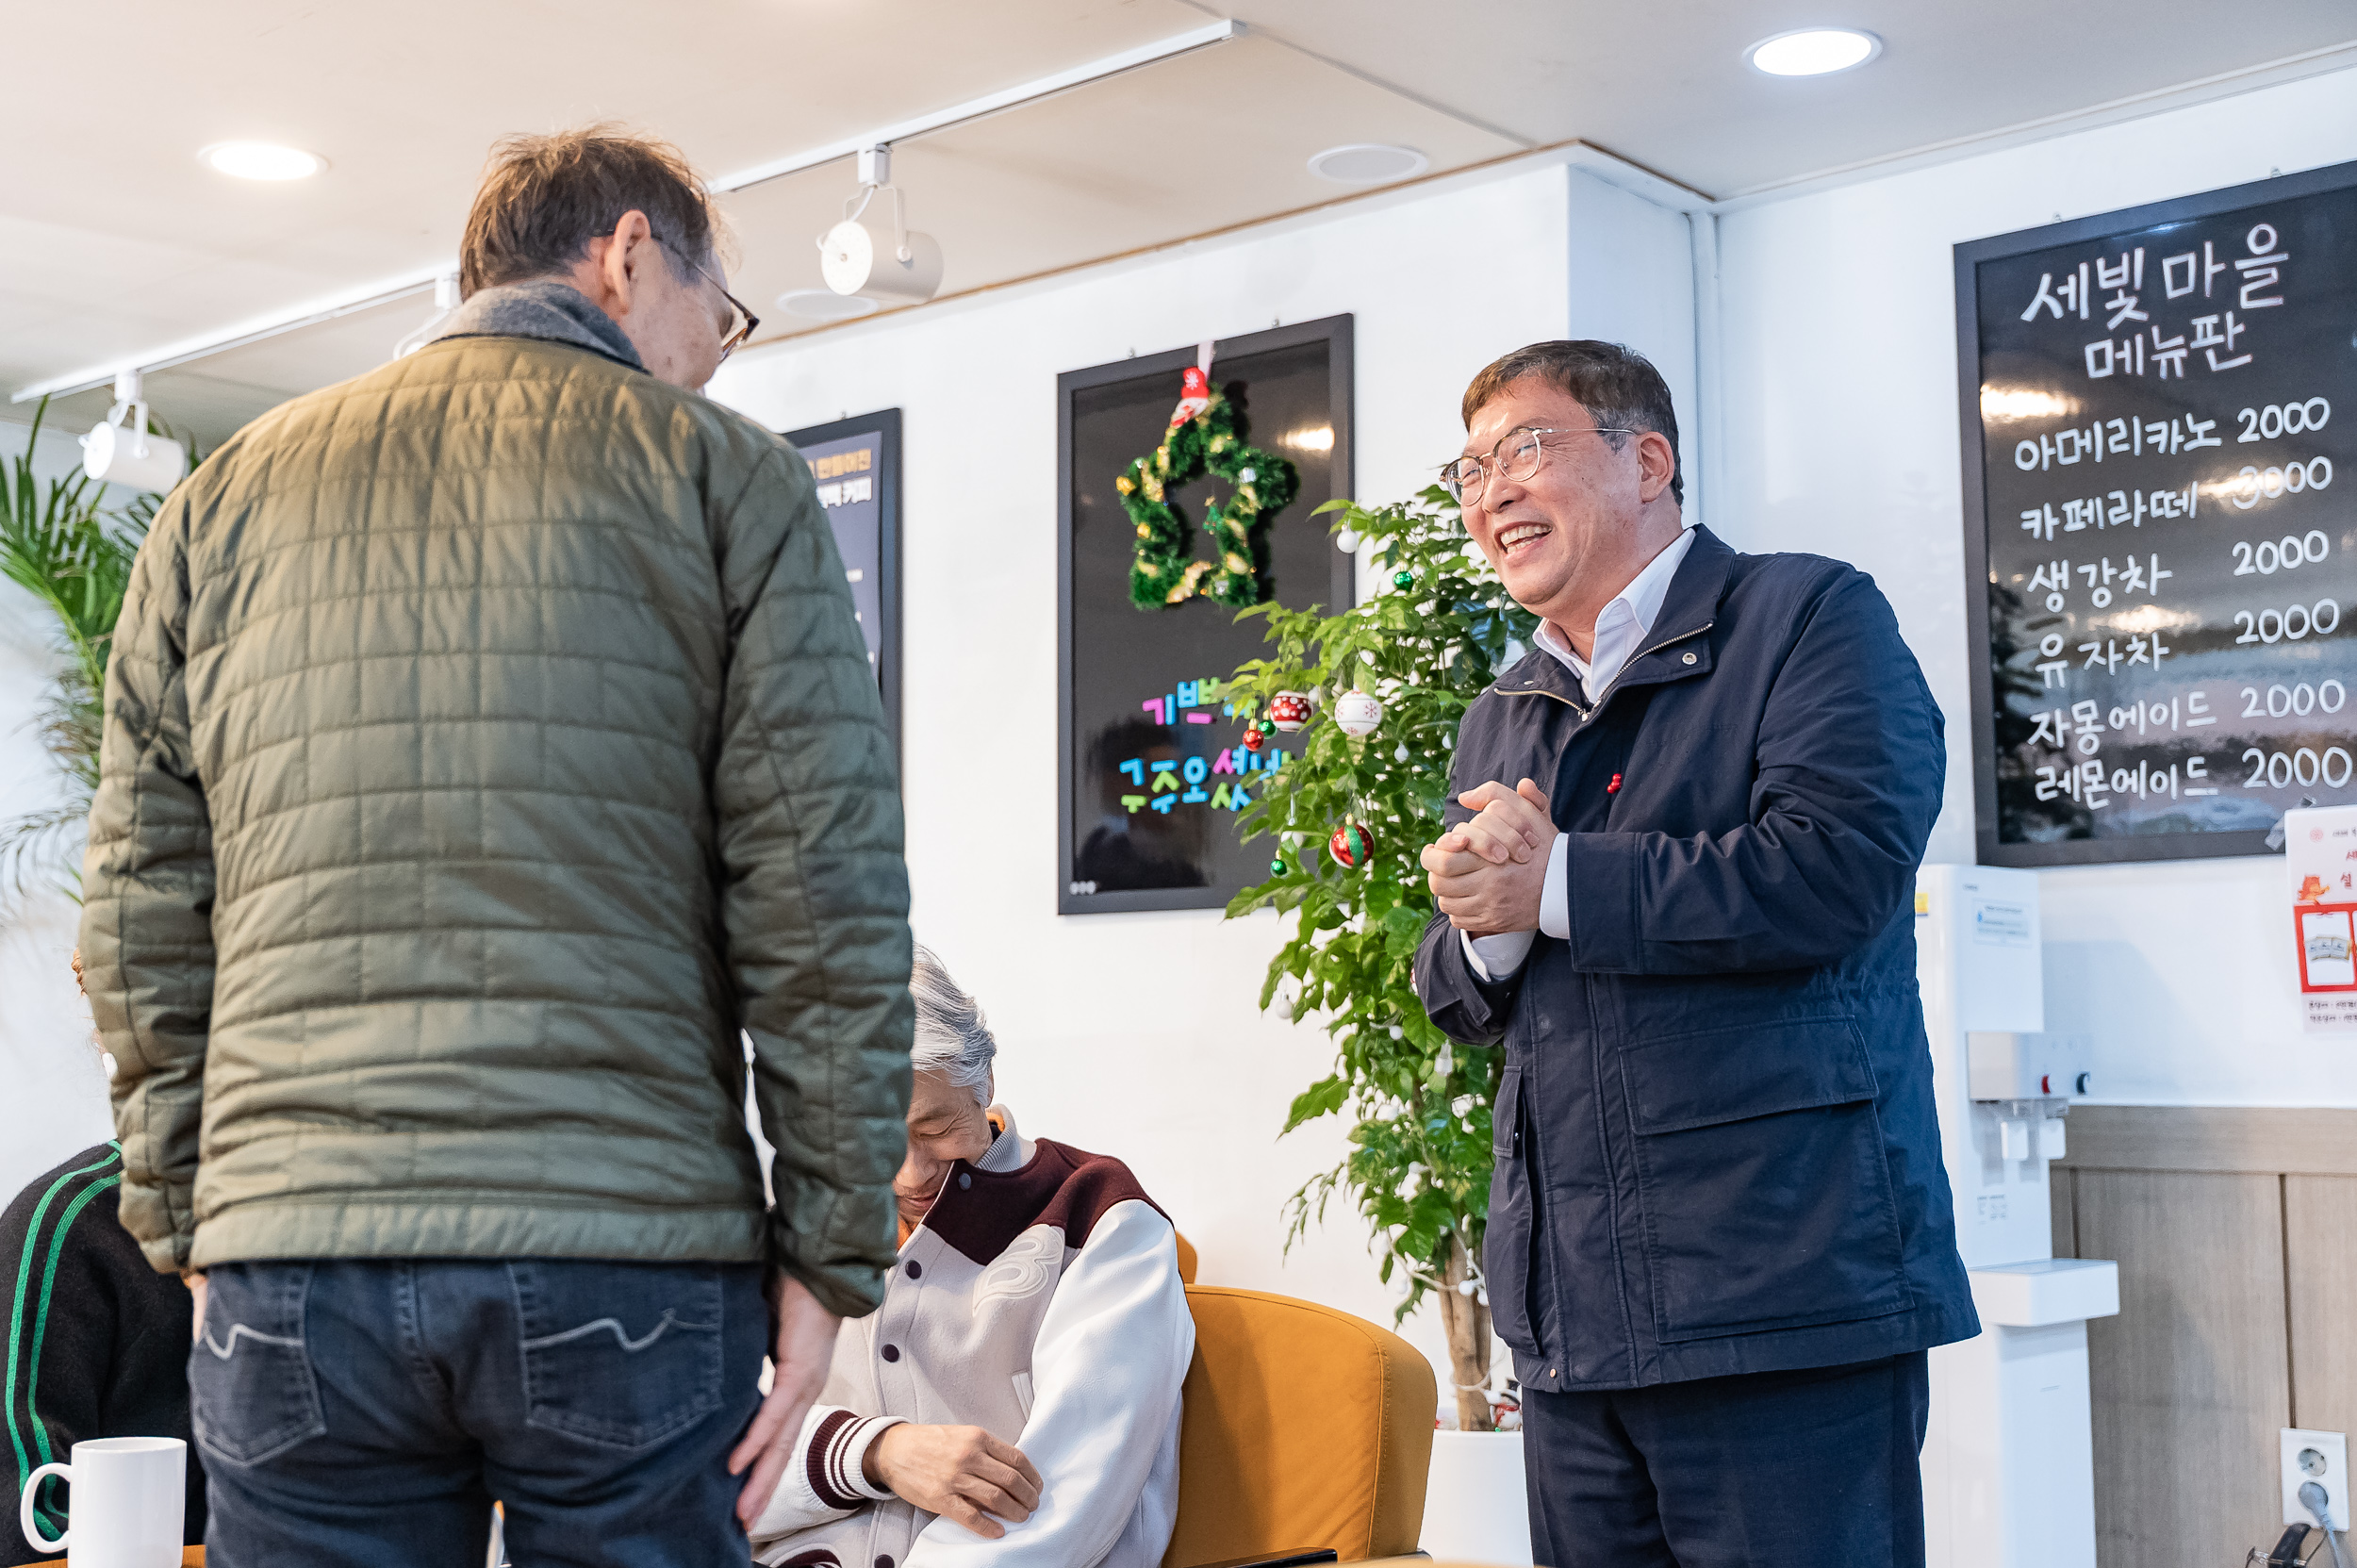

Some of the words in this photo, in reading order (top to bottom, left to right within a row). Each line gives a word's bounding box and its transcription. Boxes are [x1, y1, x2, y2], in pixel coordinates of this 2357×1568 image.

[2084, 309, 2253, 380] 메뉴판
[2014, 412, 2222, 471] 아메리카노
[2237, 396, 2331, 443] 2000
[2019, 480, 2199, 541] 카페라떼
[2232, 455, 2333, 509] 3000
[2026, 553, 2173, 613] 생강차
[2232, 530, 2330, 577] 2000
[2035, 632, 2170, 689] 유자차
[2233, 598, 2340, 644] 2000
[2027, 689, 2217, 754] 자몽에이드
[2240, 679, 2346, 718] 2000
[2035, 756, 2219, 811] 레몬에이드
[2242, 746, 2353, 789] 2000
